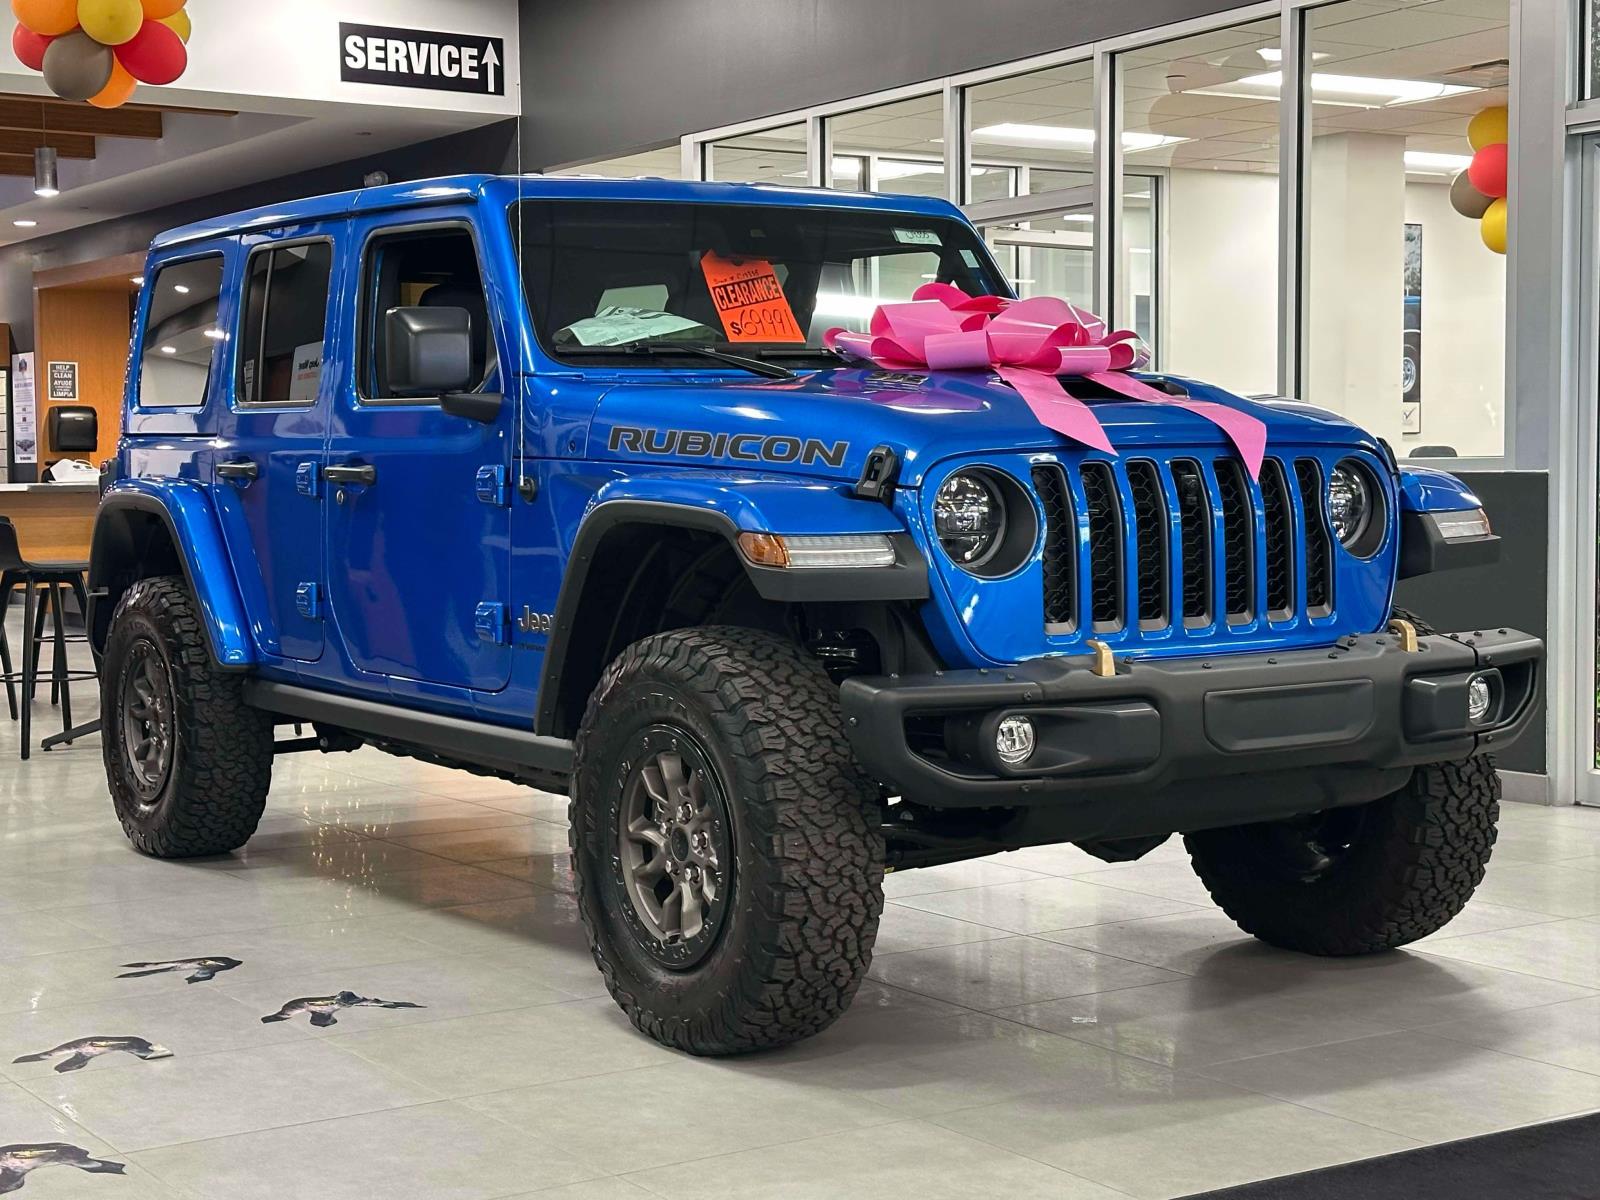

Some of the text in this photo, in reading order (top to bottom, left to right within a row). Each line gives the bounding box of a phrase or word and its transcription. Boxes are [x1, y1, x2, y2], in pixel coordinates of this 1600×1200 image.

[344, 34, 479, 80] SERVICE
[714, 276, 781, 310] CLEARANCE
[607, 425, 850, 468] RUBICON
[517, 604, 554, 632] Jee
